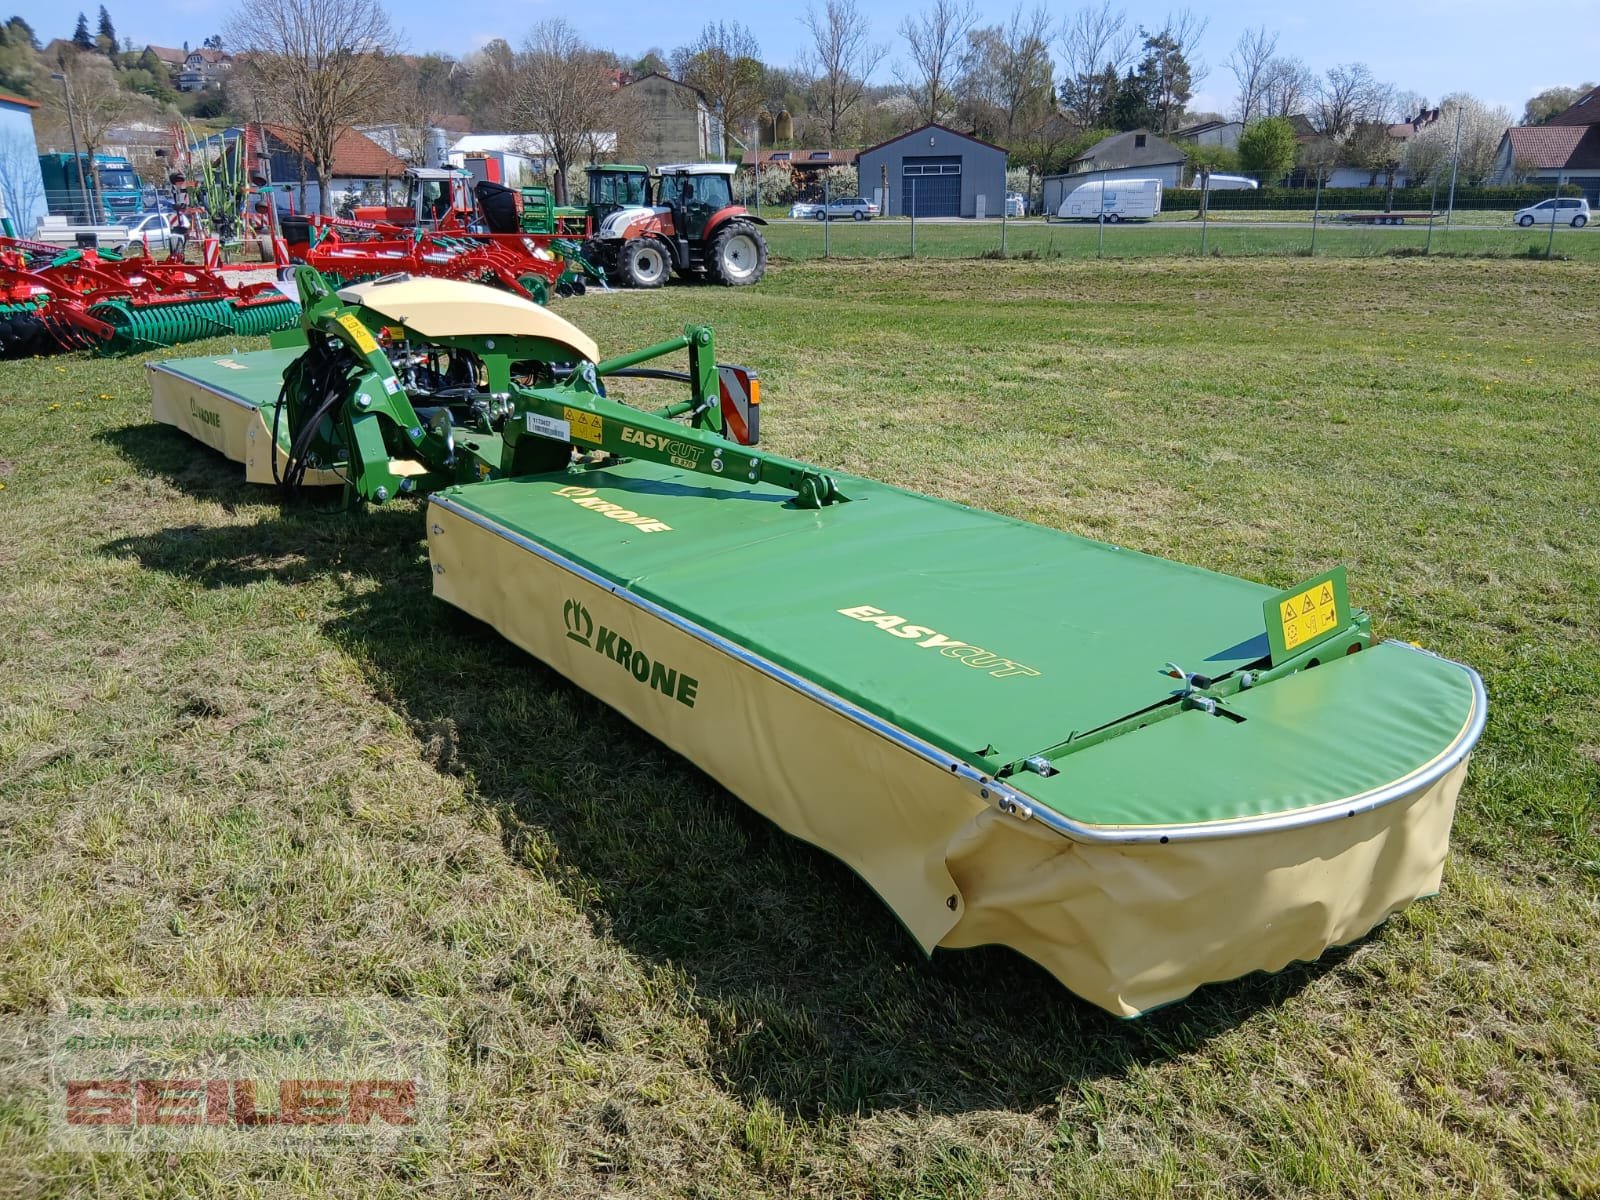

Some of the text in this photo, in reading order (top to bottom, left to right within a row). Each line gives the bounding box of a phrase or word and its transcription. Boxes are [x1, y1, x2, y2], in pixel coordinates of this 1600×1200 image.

[621, 426, 705, 462] EASYCUT
[571, 496, 674, 533] KRONE
[595, 625, 699, 709] KRONE
[836, 604, 1042, 678] EASYCUT
